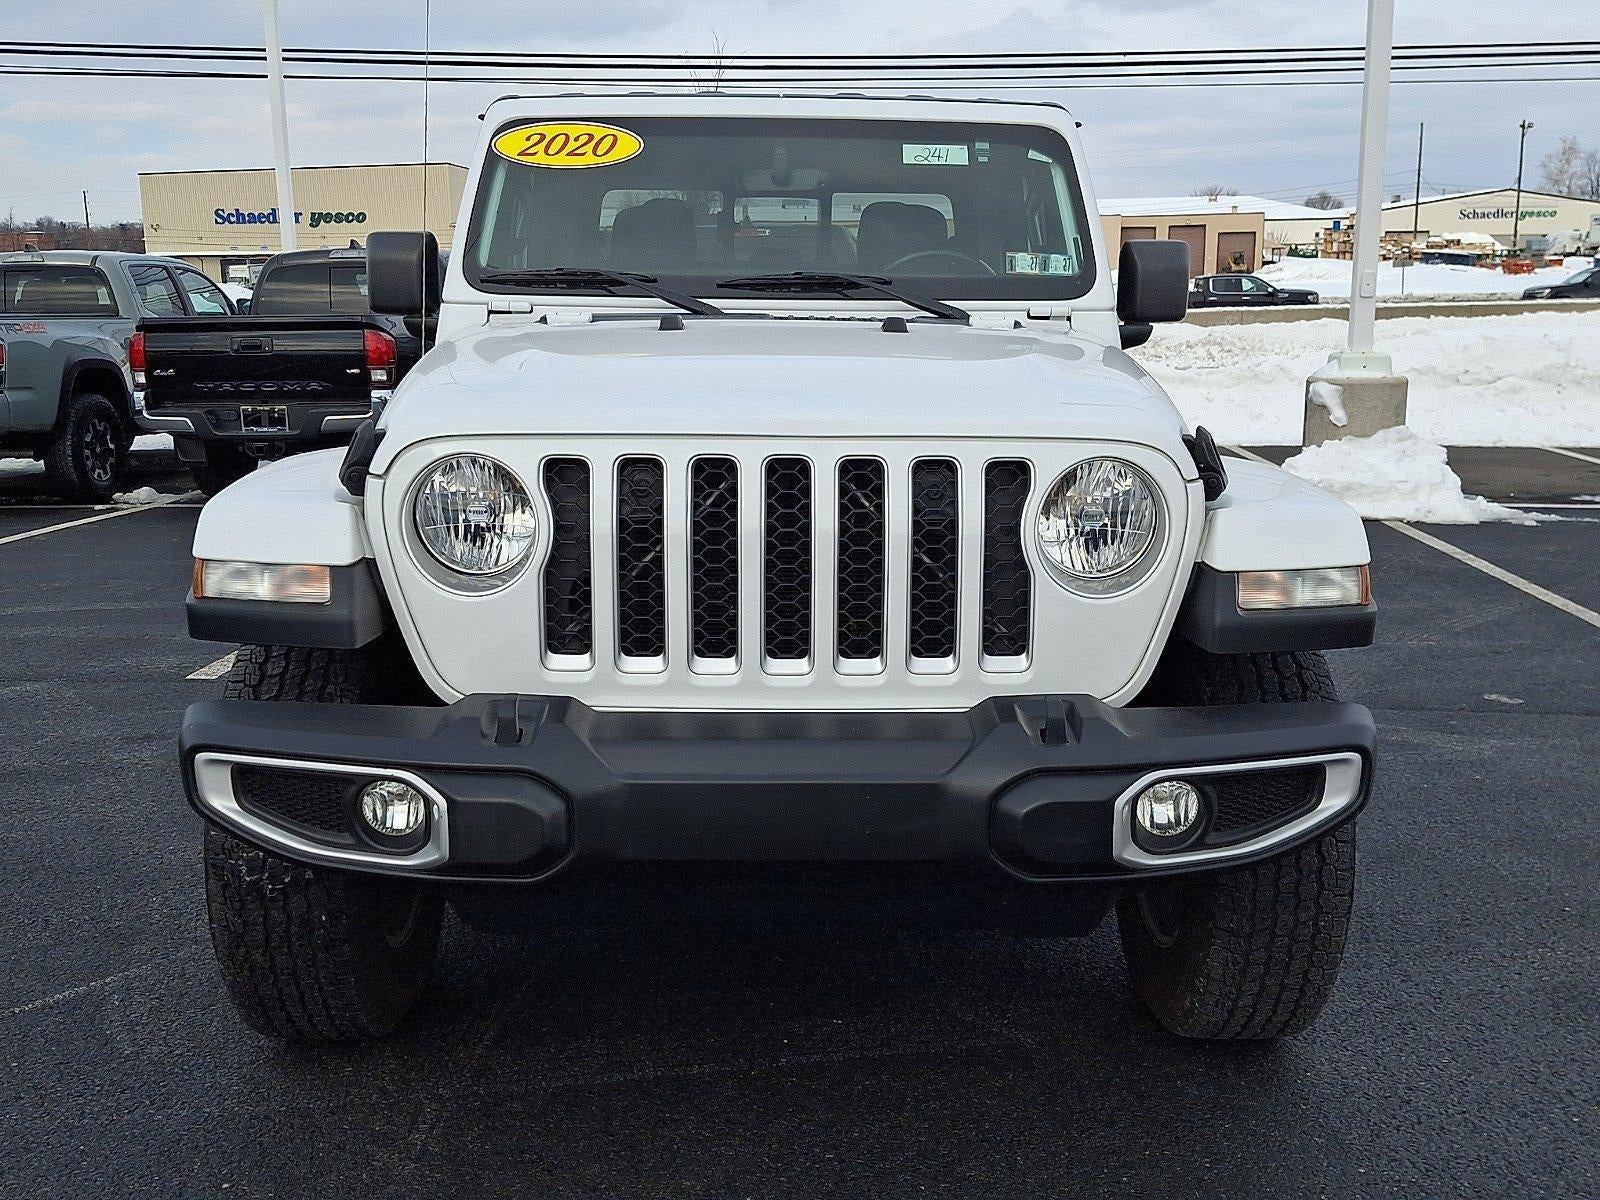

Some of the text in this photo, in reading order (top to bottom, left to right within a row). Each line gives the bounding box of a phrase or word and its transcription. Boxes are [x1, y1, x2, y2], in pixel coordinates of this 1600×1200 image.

[516, 132, 619, 158] 2020
[913, 147, 951, 164] 241
[308, 210, 367, 228] yesco
[1458, 208, 1558, 221] Schaedler yesco
[193, 381, 325, 391] TACOMA
